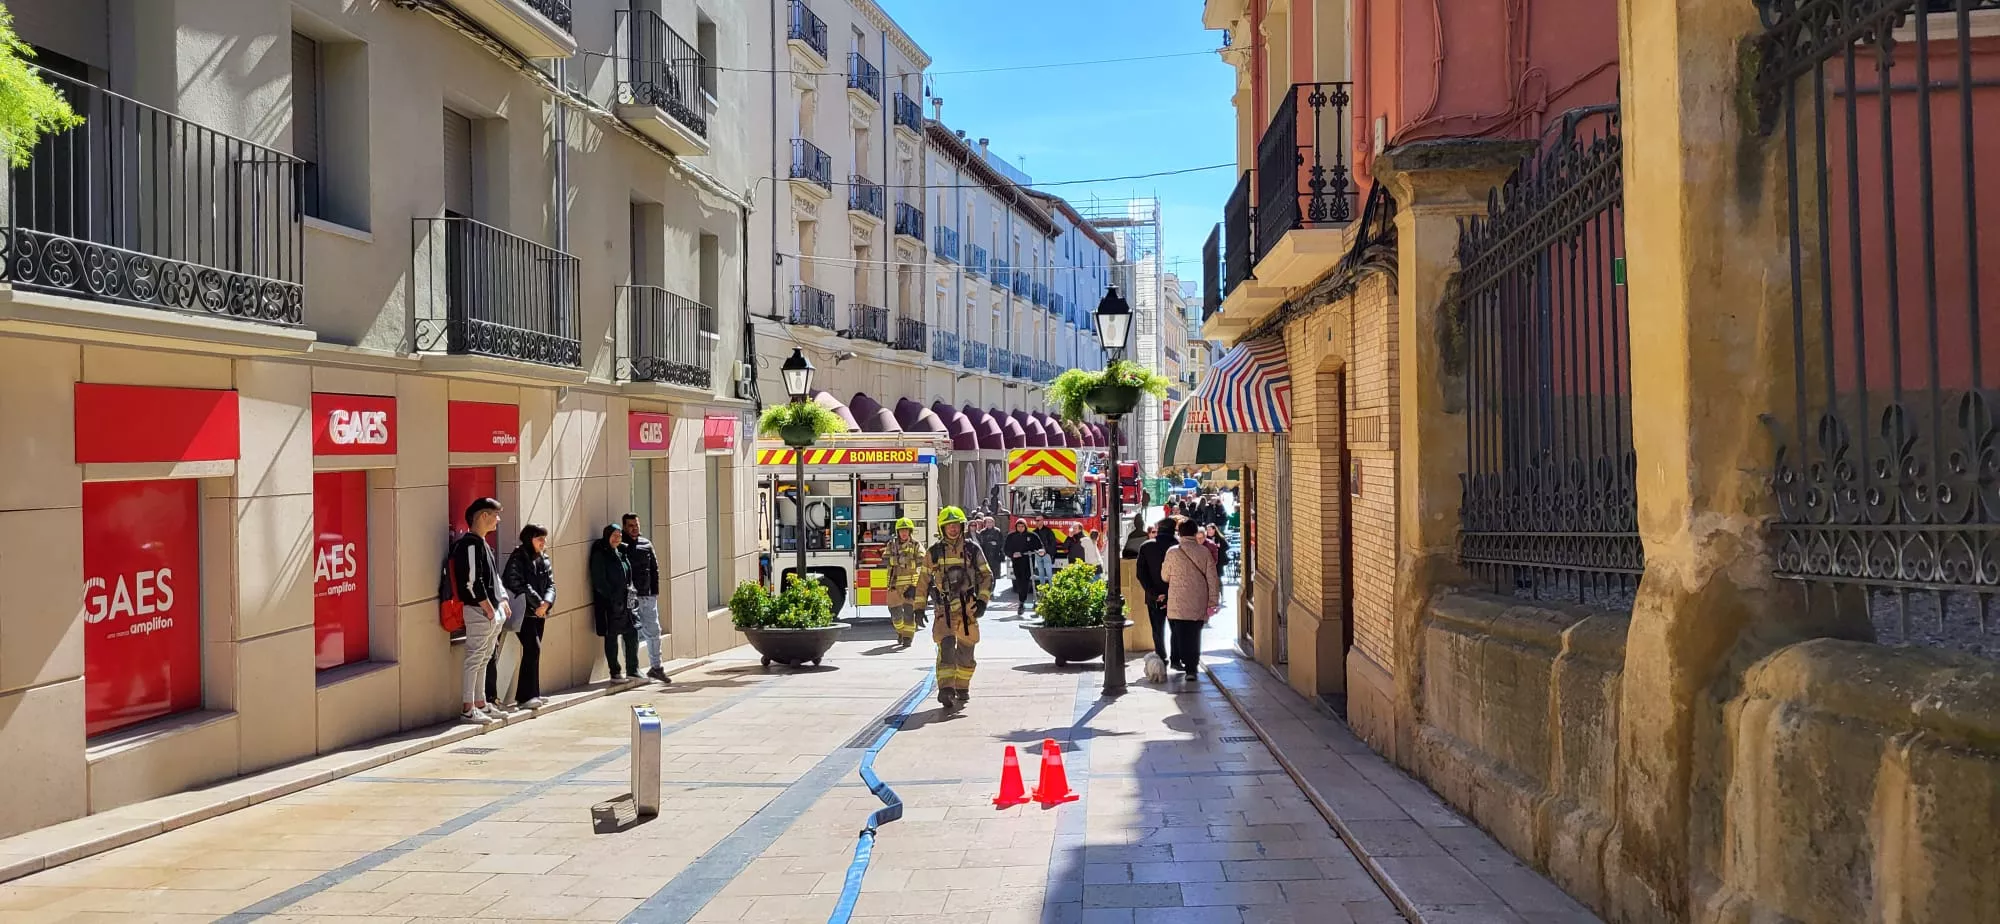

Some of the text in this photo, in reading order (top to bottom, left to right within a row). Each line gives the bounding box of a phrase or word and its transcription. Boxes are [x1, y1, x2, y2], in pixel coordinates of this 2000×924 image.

[329, 410, 388, 444] GAES
[640, 422, 662, 443] GAES
[492, 434, 516, 446] amplifon
[849, 451, 914, 463] BOMBEROS
[83, 568, 174, 624] GAES
[327, 581, 357, 597] amplifon
[129, 616, 174, 636] amplifon
